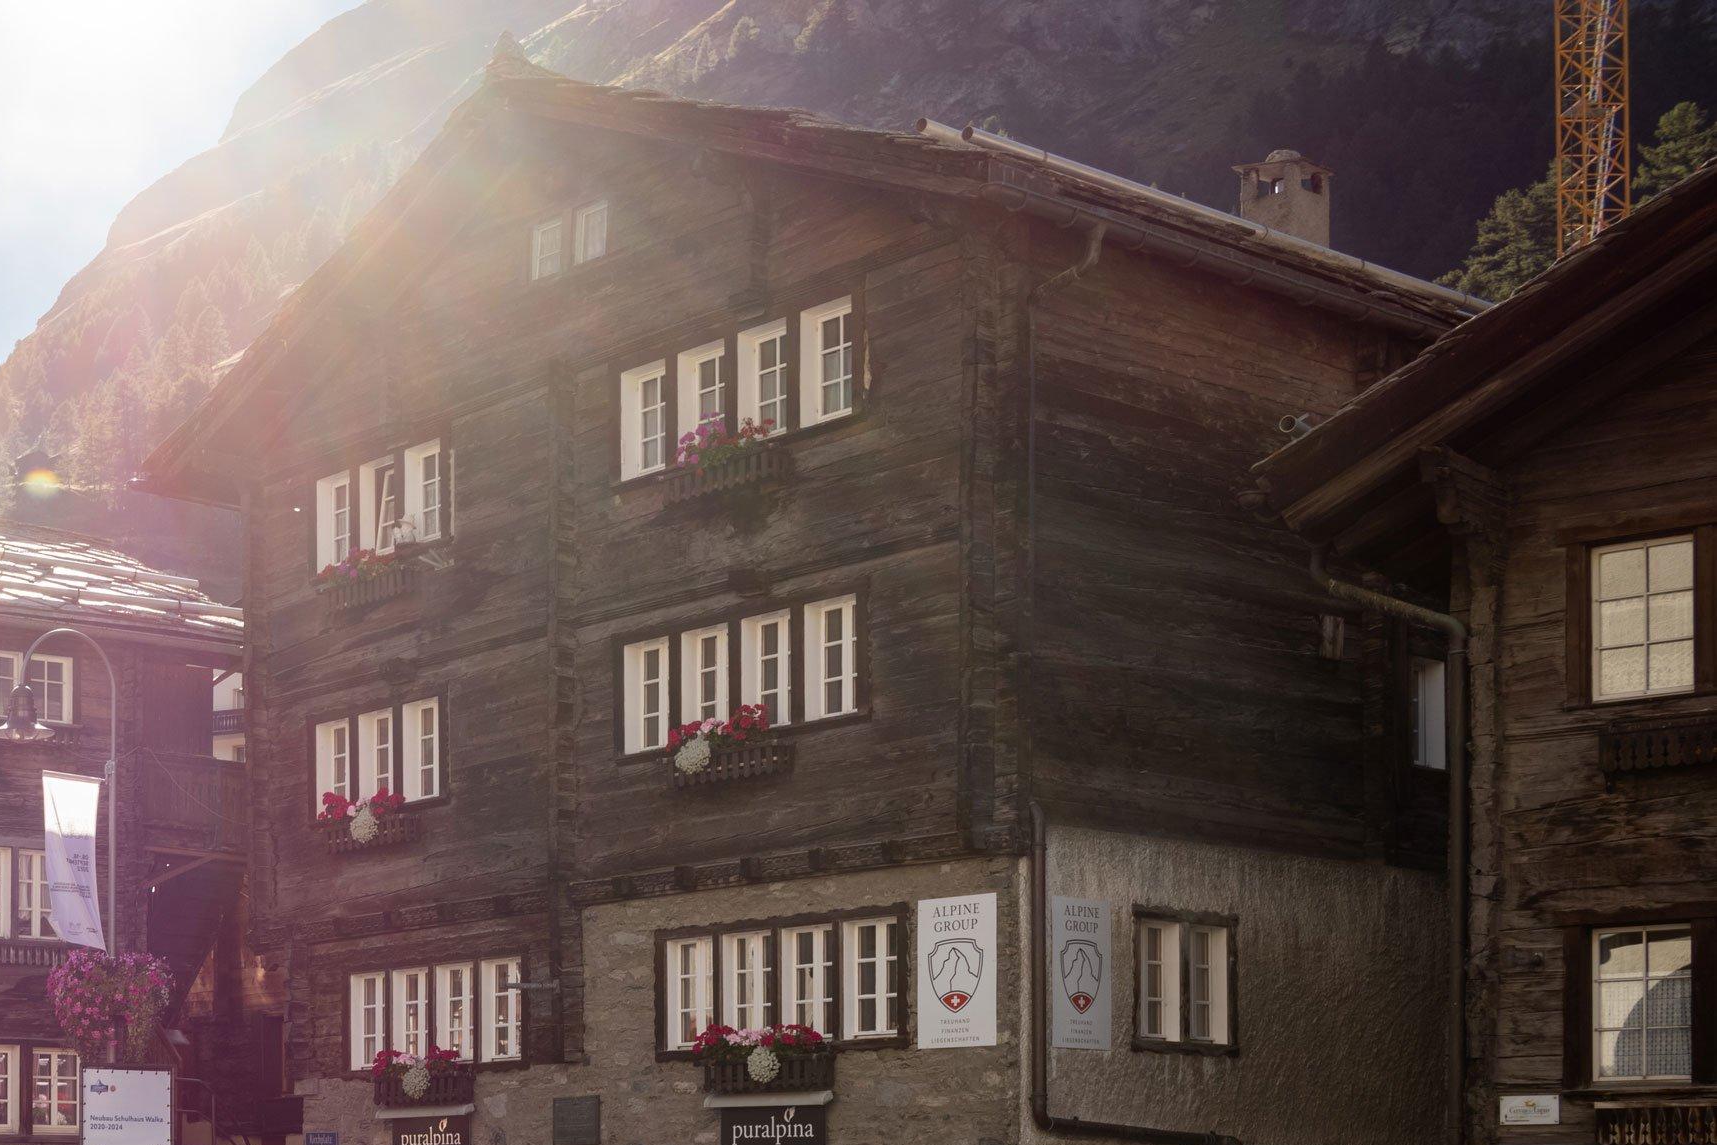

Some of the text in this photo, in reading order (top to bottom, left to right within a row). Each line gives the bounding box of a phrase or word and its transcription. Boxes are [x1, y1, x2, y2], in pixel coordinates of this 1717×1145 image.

[933, 903, 980, 918] ALPINE
[1064, 905, 1100, 918] ALPINE
[934, 918, 978, 933] GROUP
[1065, 920, 1099, 934] GROUP
[931, 1036, 980, 1044] LIEGENSCHAFTEN
[114, 1115, 144, 1123] Schulhaus
[90, 1123, 123, 1131] 2020-2024
[732, 1116, 815, 1145] puralpina
